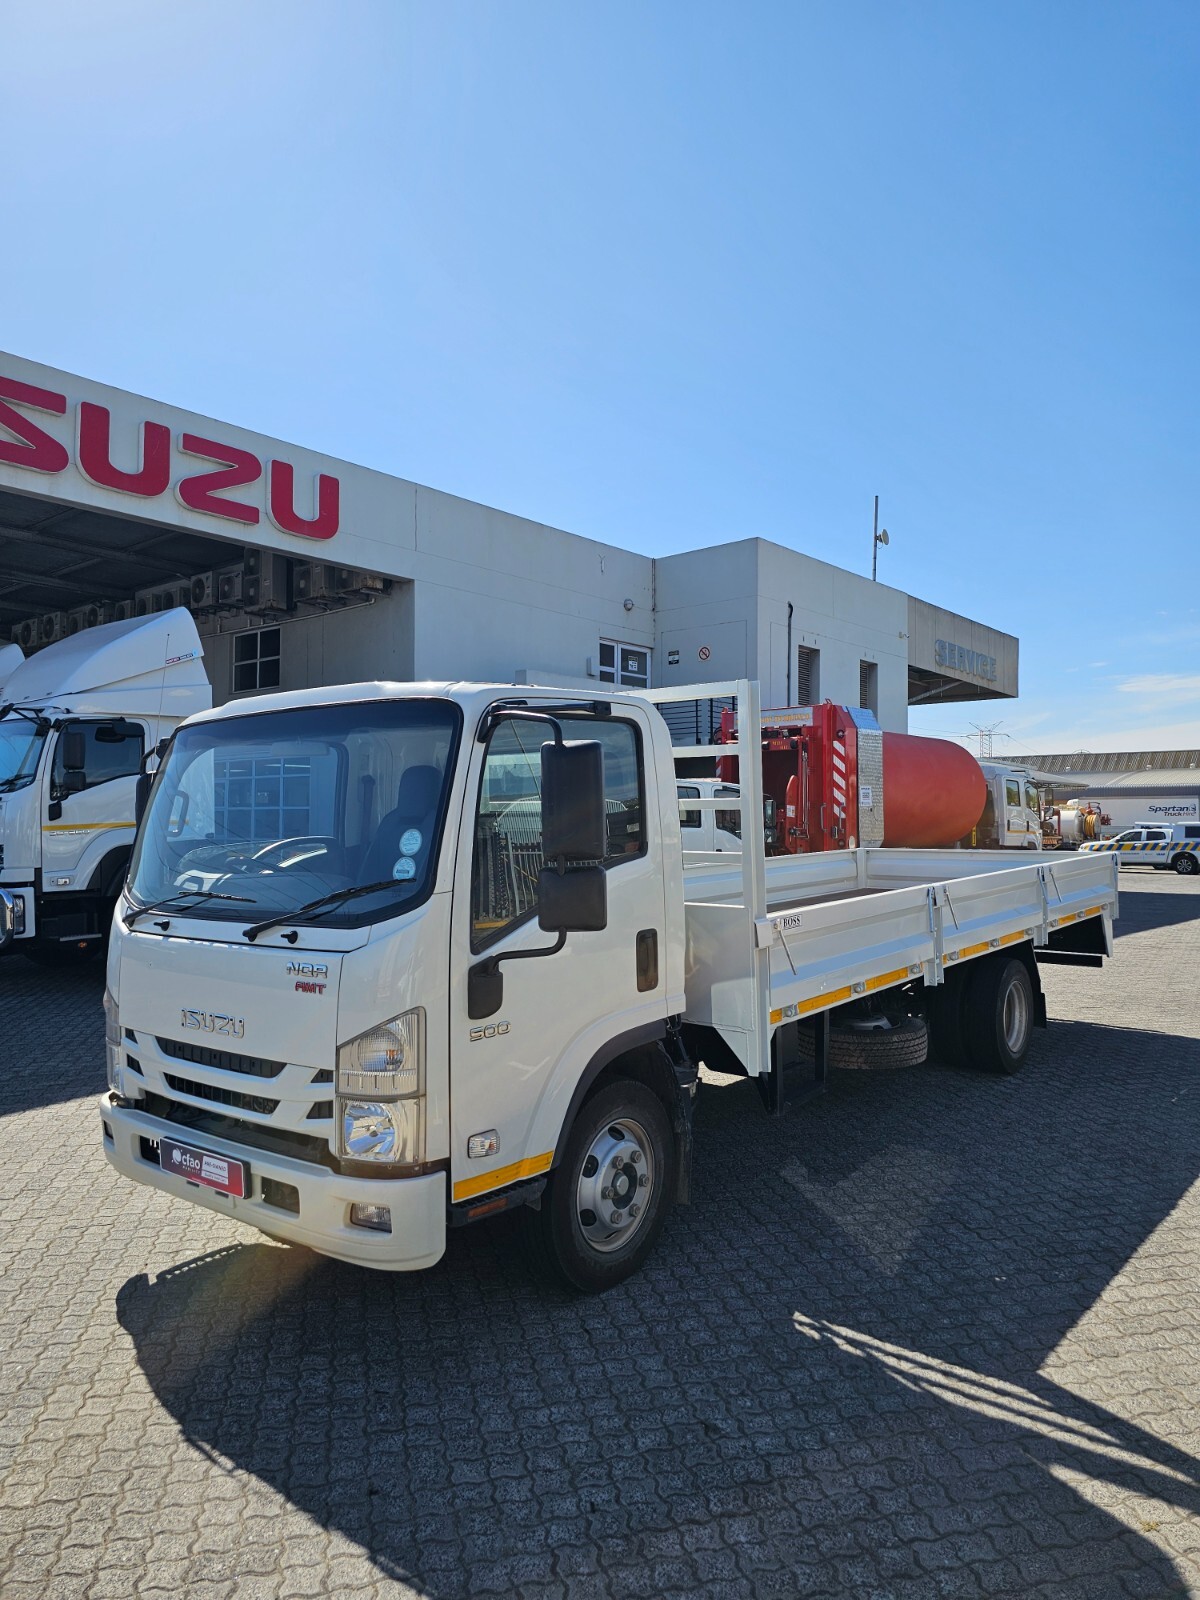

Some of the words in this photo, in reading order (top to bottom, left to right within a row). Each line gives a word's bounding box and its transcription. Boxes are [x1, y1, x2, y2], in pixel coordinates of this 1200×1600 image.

[934, 639, 997, 681] SERVICE
[783, 914, 801, 928] BOSS
[286, 961, 329, 979] NQR
[295, 981, 327, 995] AMT
[180, 1008, 245, 1039] ISUZU
[469, 1020, 512, 1042] 500
[182, 1154, 200, 1169] cfao
